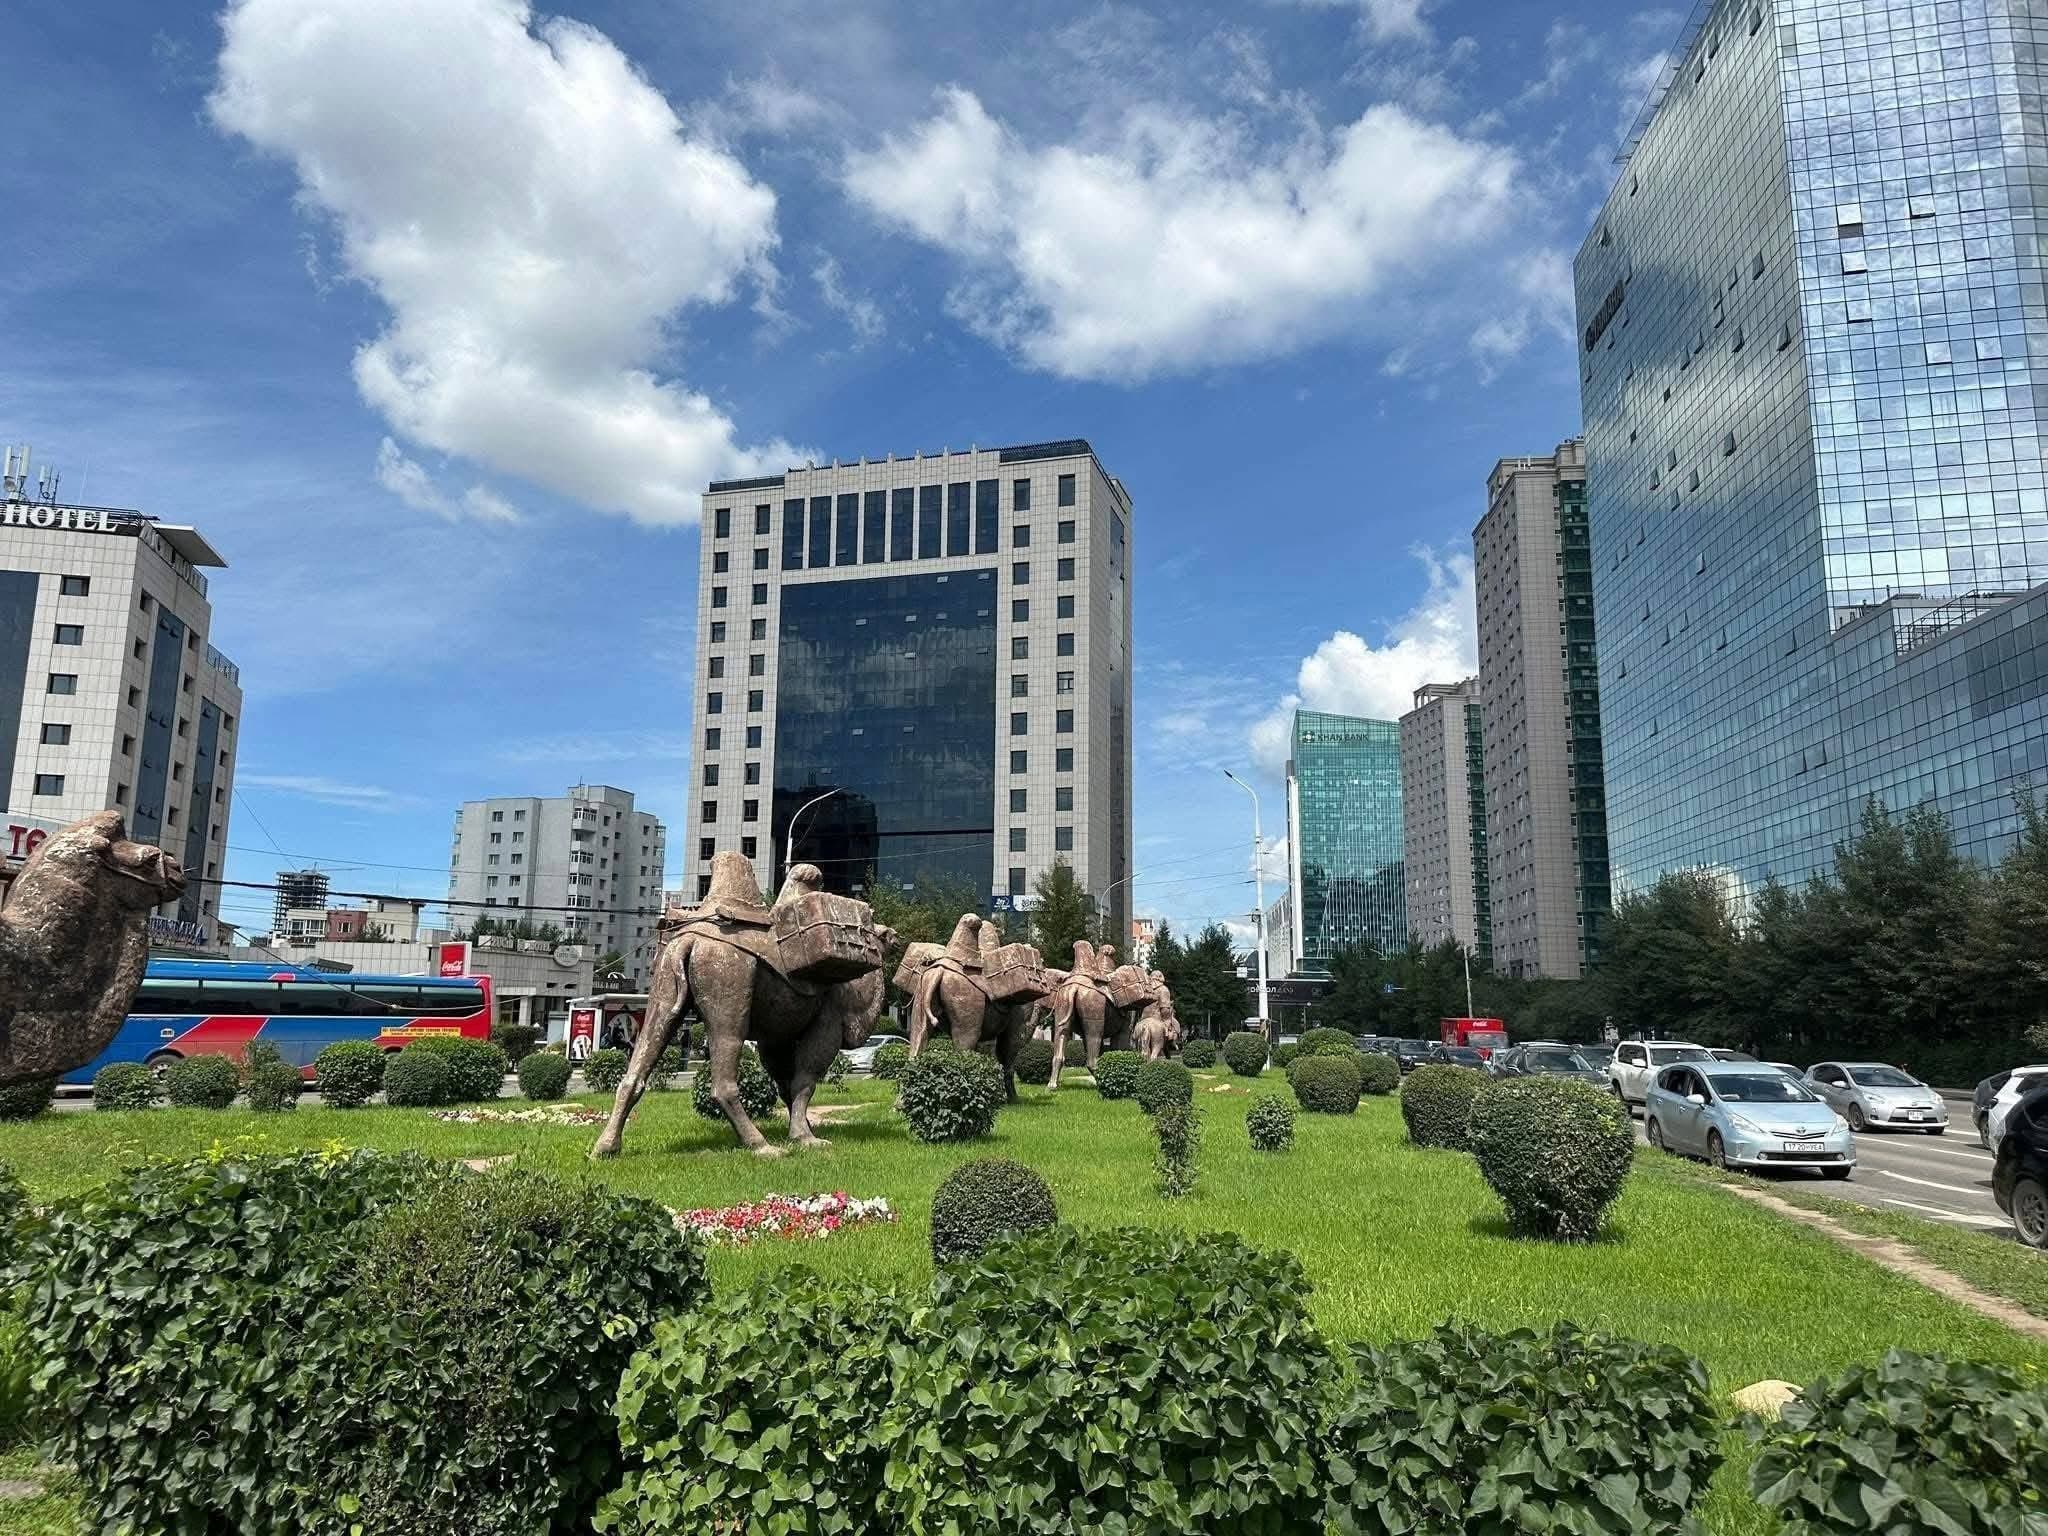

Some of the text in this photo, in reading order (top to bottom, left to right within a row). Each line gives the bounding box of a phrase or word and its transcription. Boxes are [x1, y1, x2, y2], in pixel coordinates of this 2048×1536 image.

[2, 504, 118, 532] HOTEL
[1317, 733, 1369, 742] KHAN BANK
